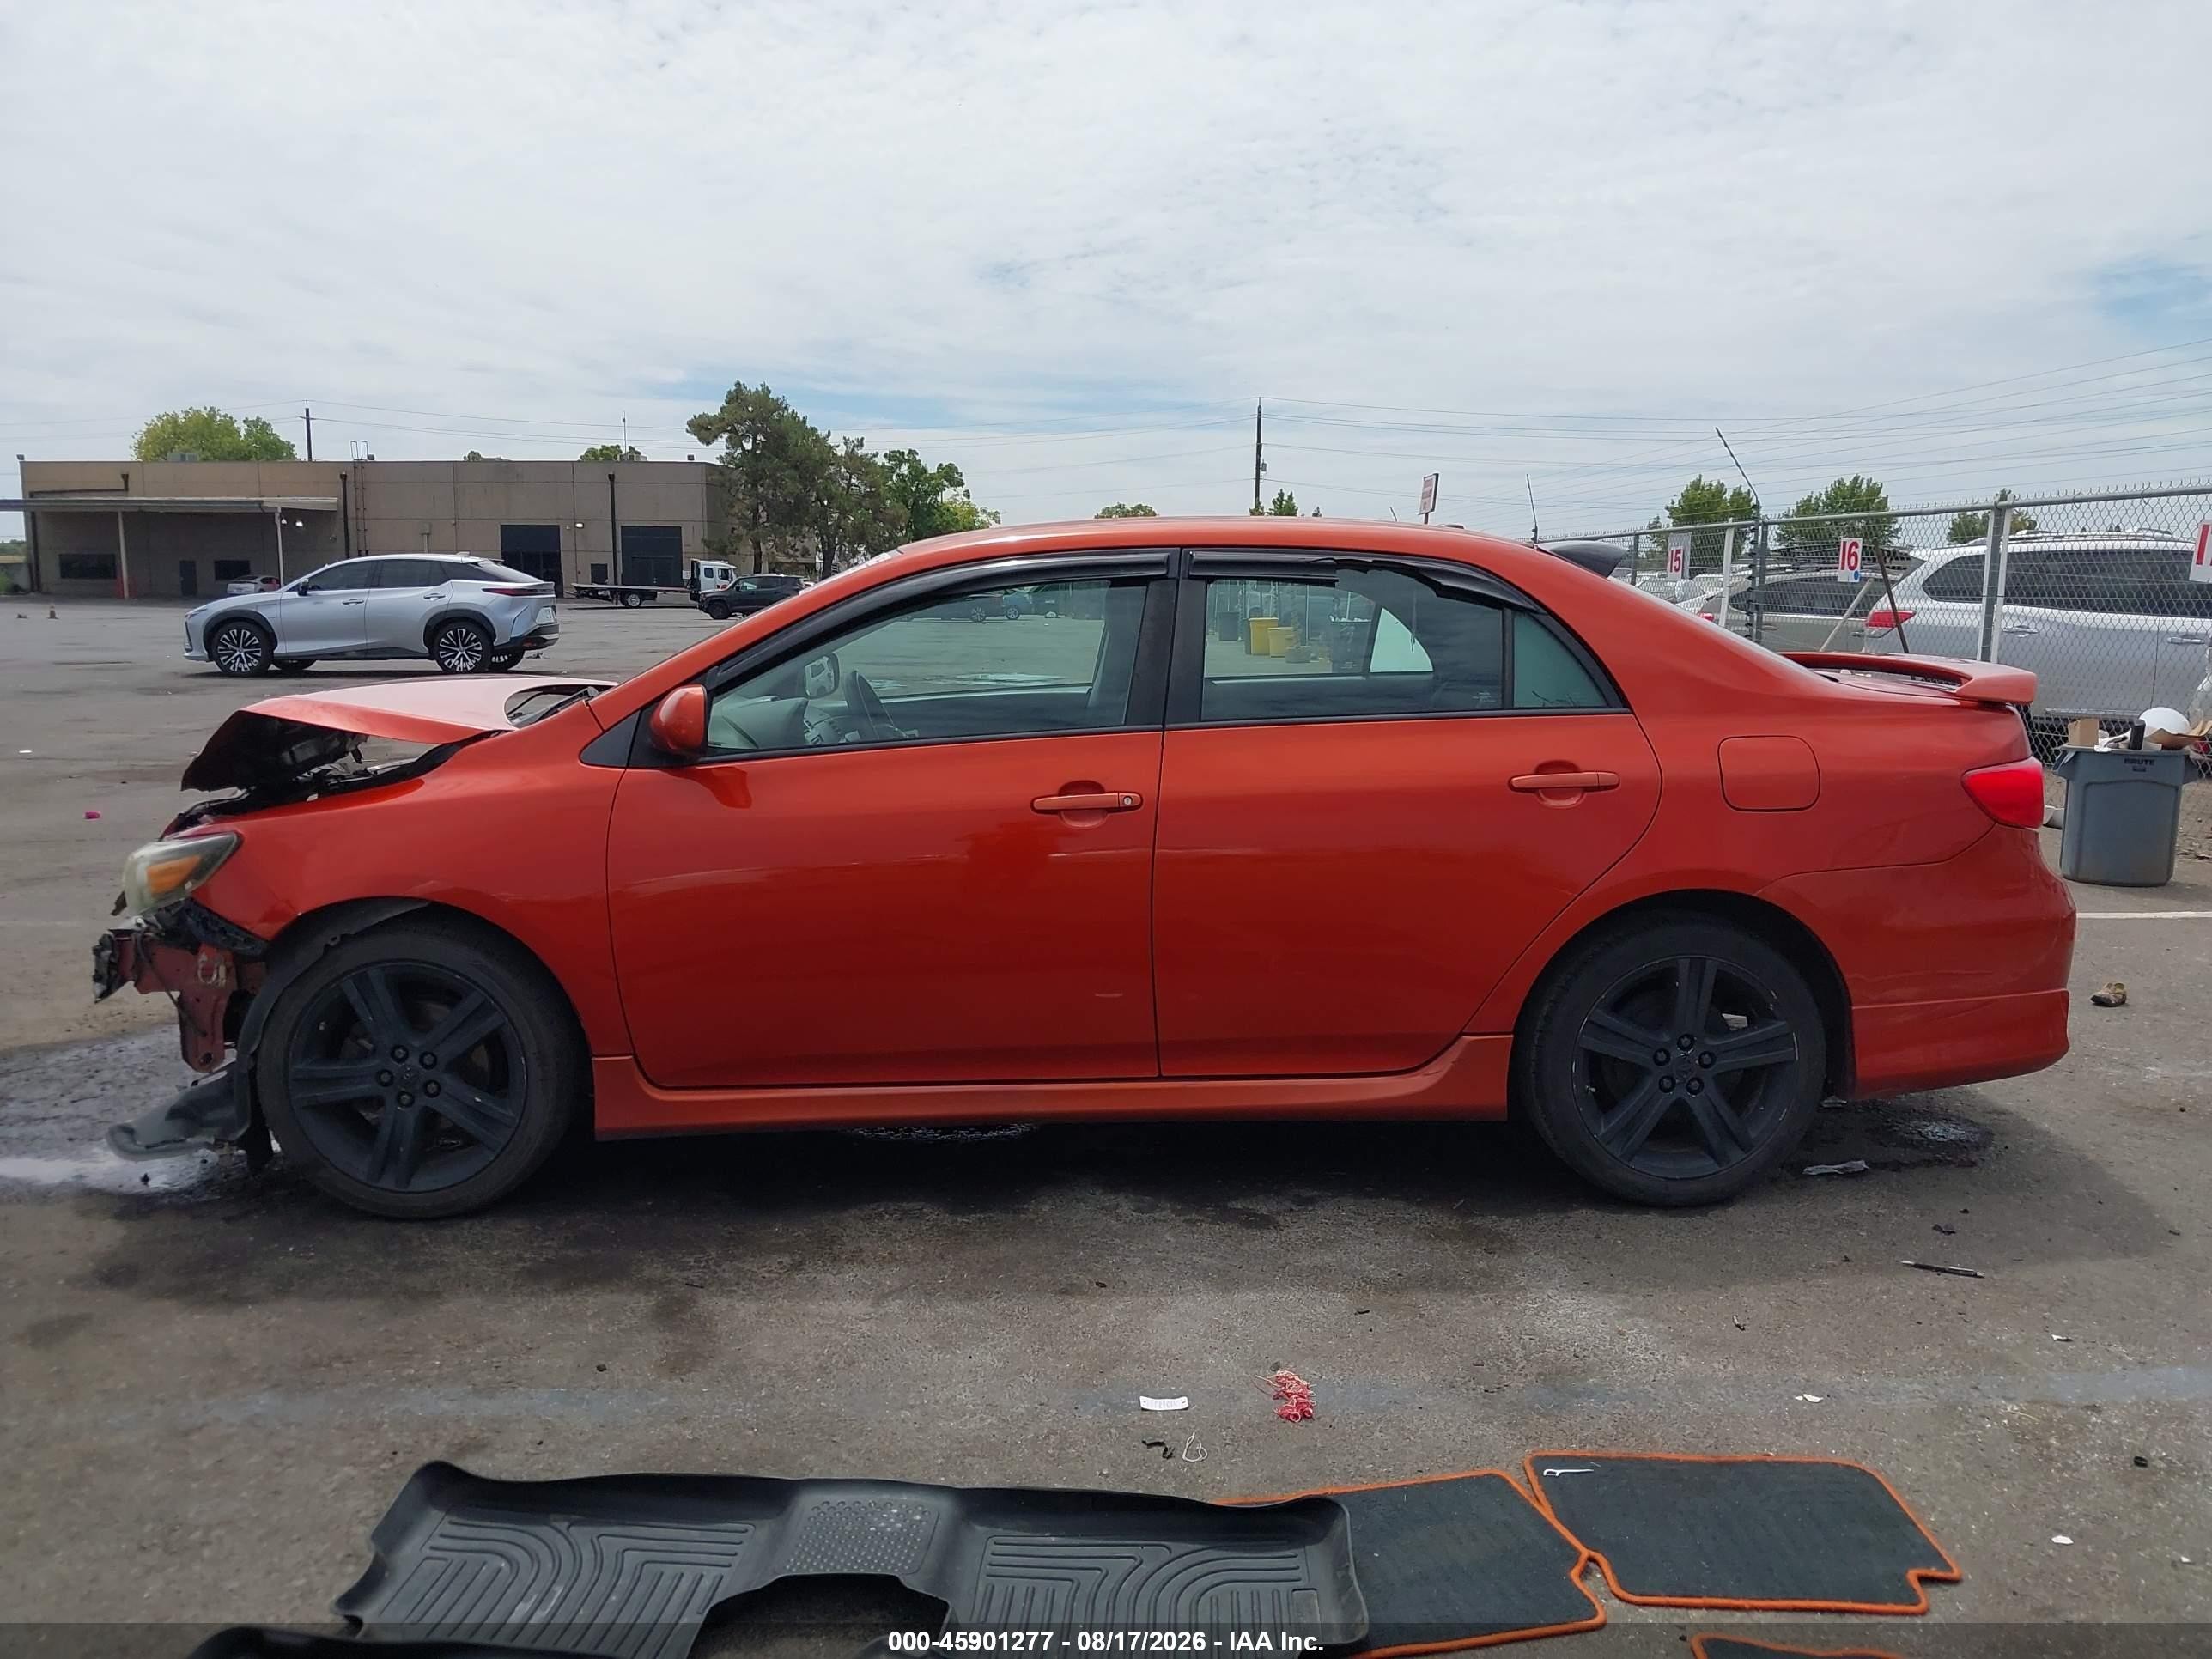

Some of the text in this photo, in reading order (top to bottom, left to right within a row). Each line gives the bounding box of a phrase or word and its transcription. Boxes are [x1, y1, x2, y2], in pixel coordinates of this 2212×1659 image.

[1840, 540, 1859, 571] 16
[2195, 524, 2212, 566] 1
[1669, 549, 1681, 573] 15
